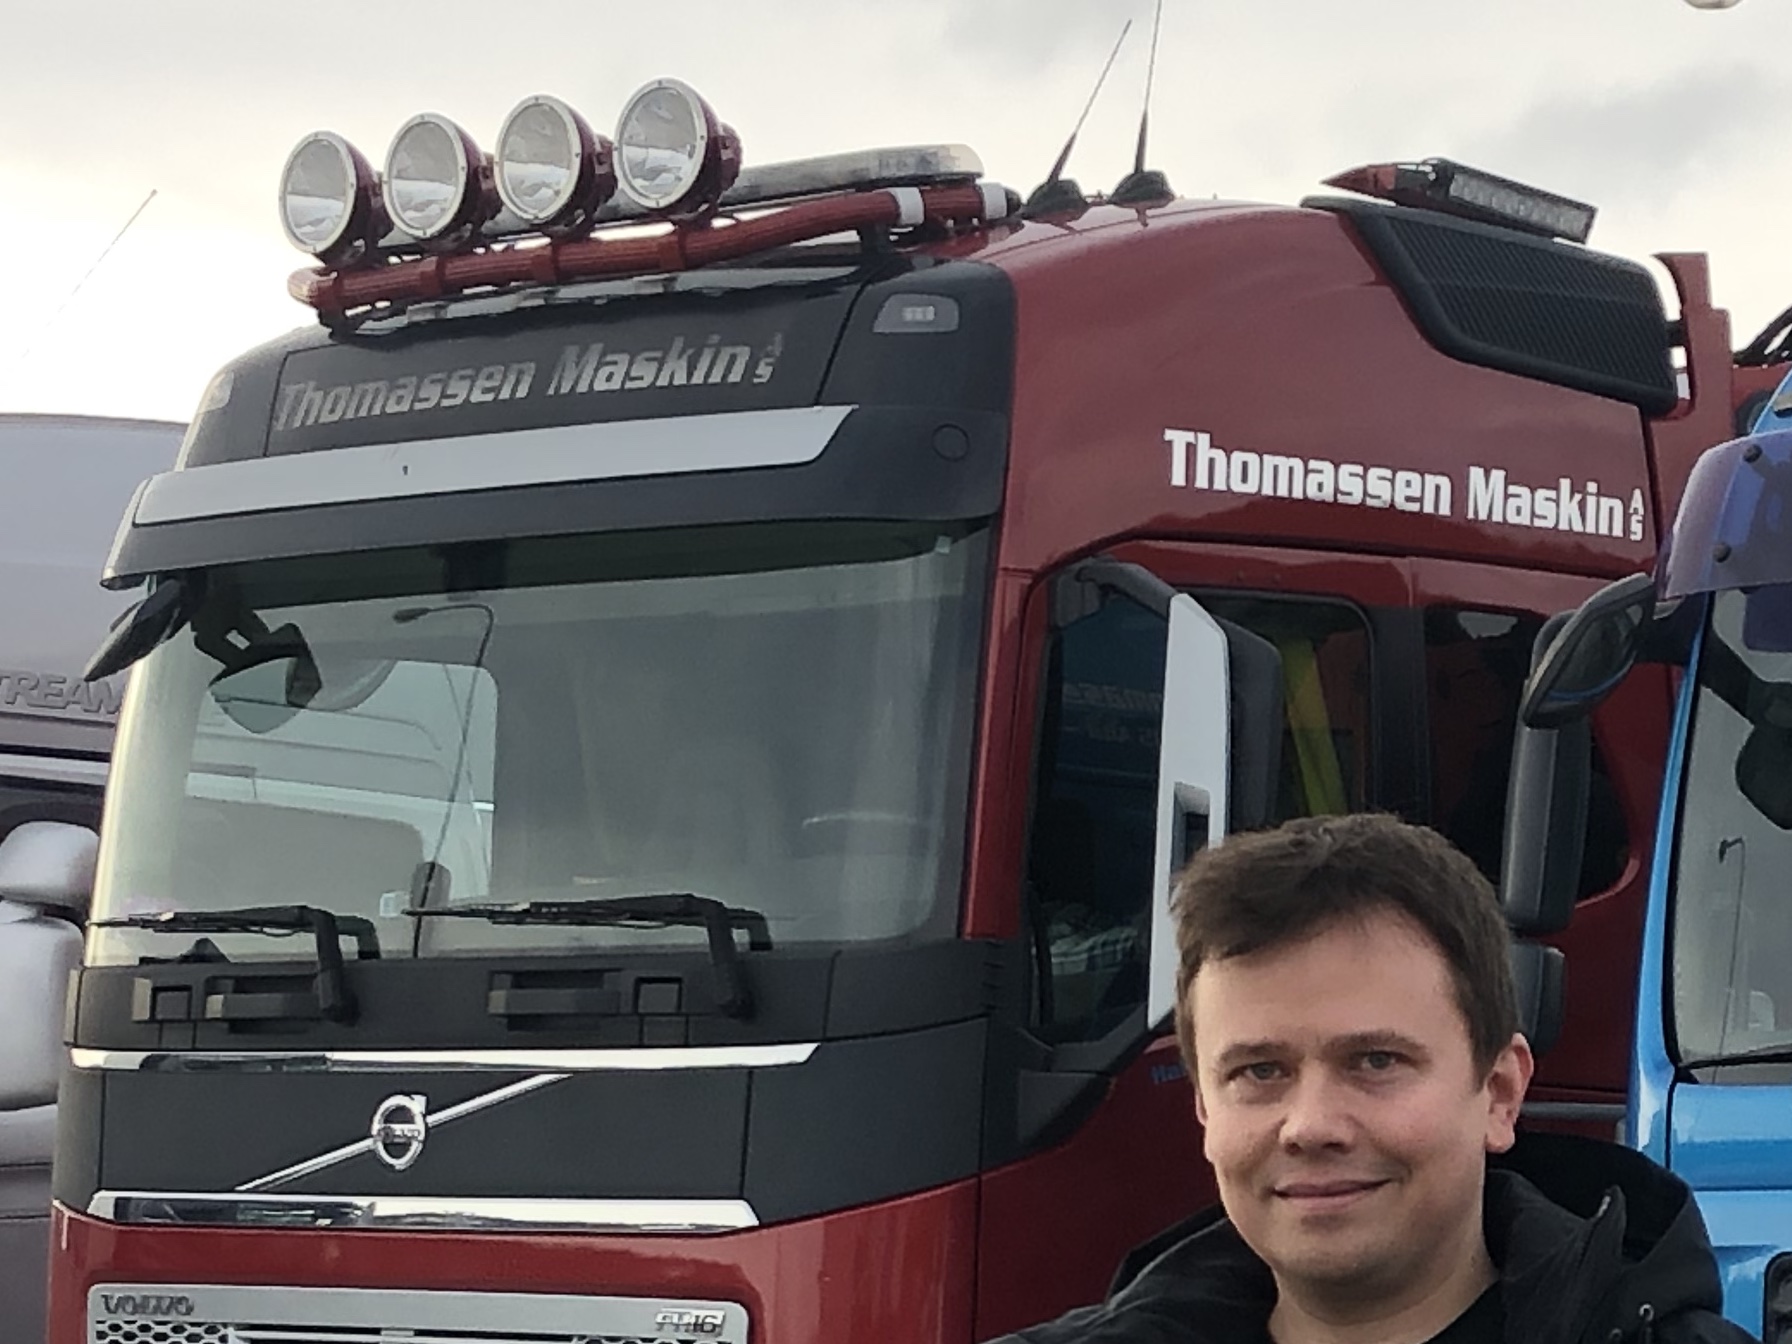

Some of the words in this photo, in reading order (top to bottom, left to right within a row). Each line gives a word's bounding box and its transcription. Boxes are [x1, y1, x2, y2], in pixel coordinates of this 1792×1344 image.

[273, 358, 537, 432] Thomassen
[547, 333, 752, 395] Maskin
[1163, 427, 1453, 517] Thomassen
[1466, 465, 1625, 540] Maskin
[101, 1294, 195, 1316] VOLVO
